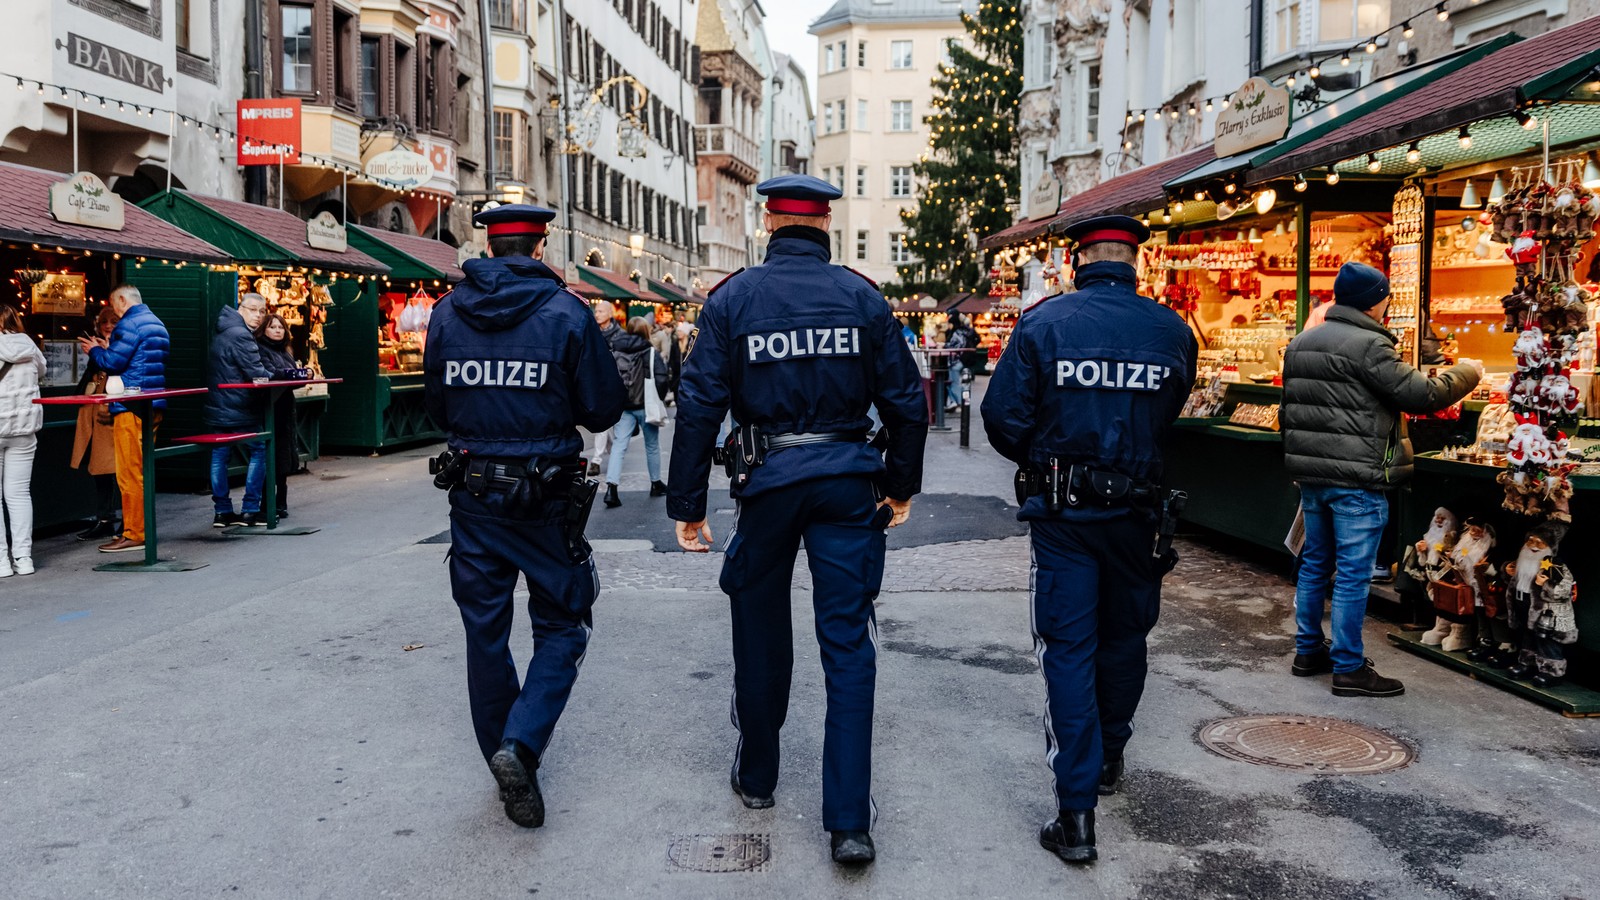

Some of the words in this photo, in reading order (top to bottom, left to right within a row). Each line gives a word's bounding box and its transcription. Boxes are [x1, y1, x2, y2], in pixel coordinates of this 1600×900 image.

[75, 37, 161, 91] BANK
[242, 108, 294, 119] MPREIS
[1218, 116, 1249, 138] Harry's
[1250, 102, 1285, 126] Exklusiv
[370, 161, 387, 175] zimt
[402, 162, 428, 175] zucker
[87, 197, 111, 213] Piano
[748, 328, 860, 361] POLIZEI
[445, 360, 548, 388] POLIZEI
